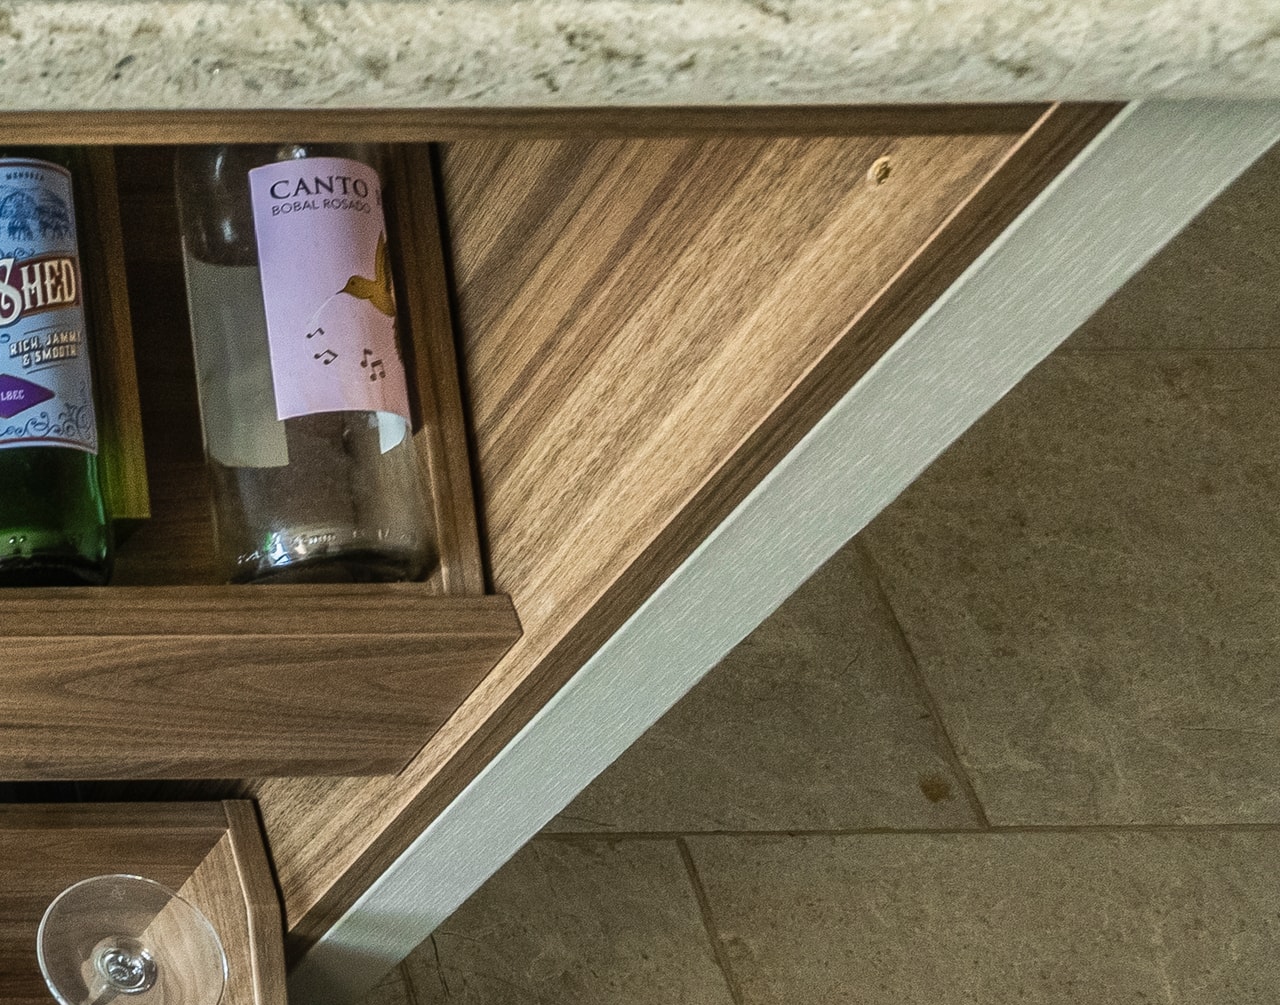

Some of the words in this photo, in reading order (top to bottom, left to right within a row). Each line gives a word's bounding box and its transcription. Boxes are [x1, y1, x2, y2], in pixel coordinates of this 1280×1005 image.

[270, 175, 368, 200] CANTO
[271, 200, 319, 216] BOBAL
[323, 199, 371, 214] ROSADO
[46, 331, 82, 346] JAMMY
[35, 345, 77, 363] SMOOTH
